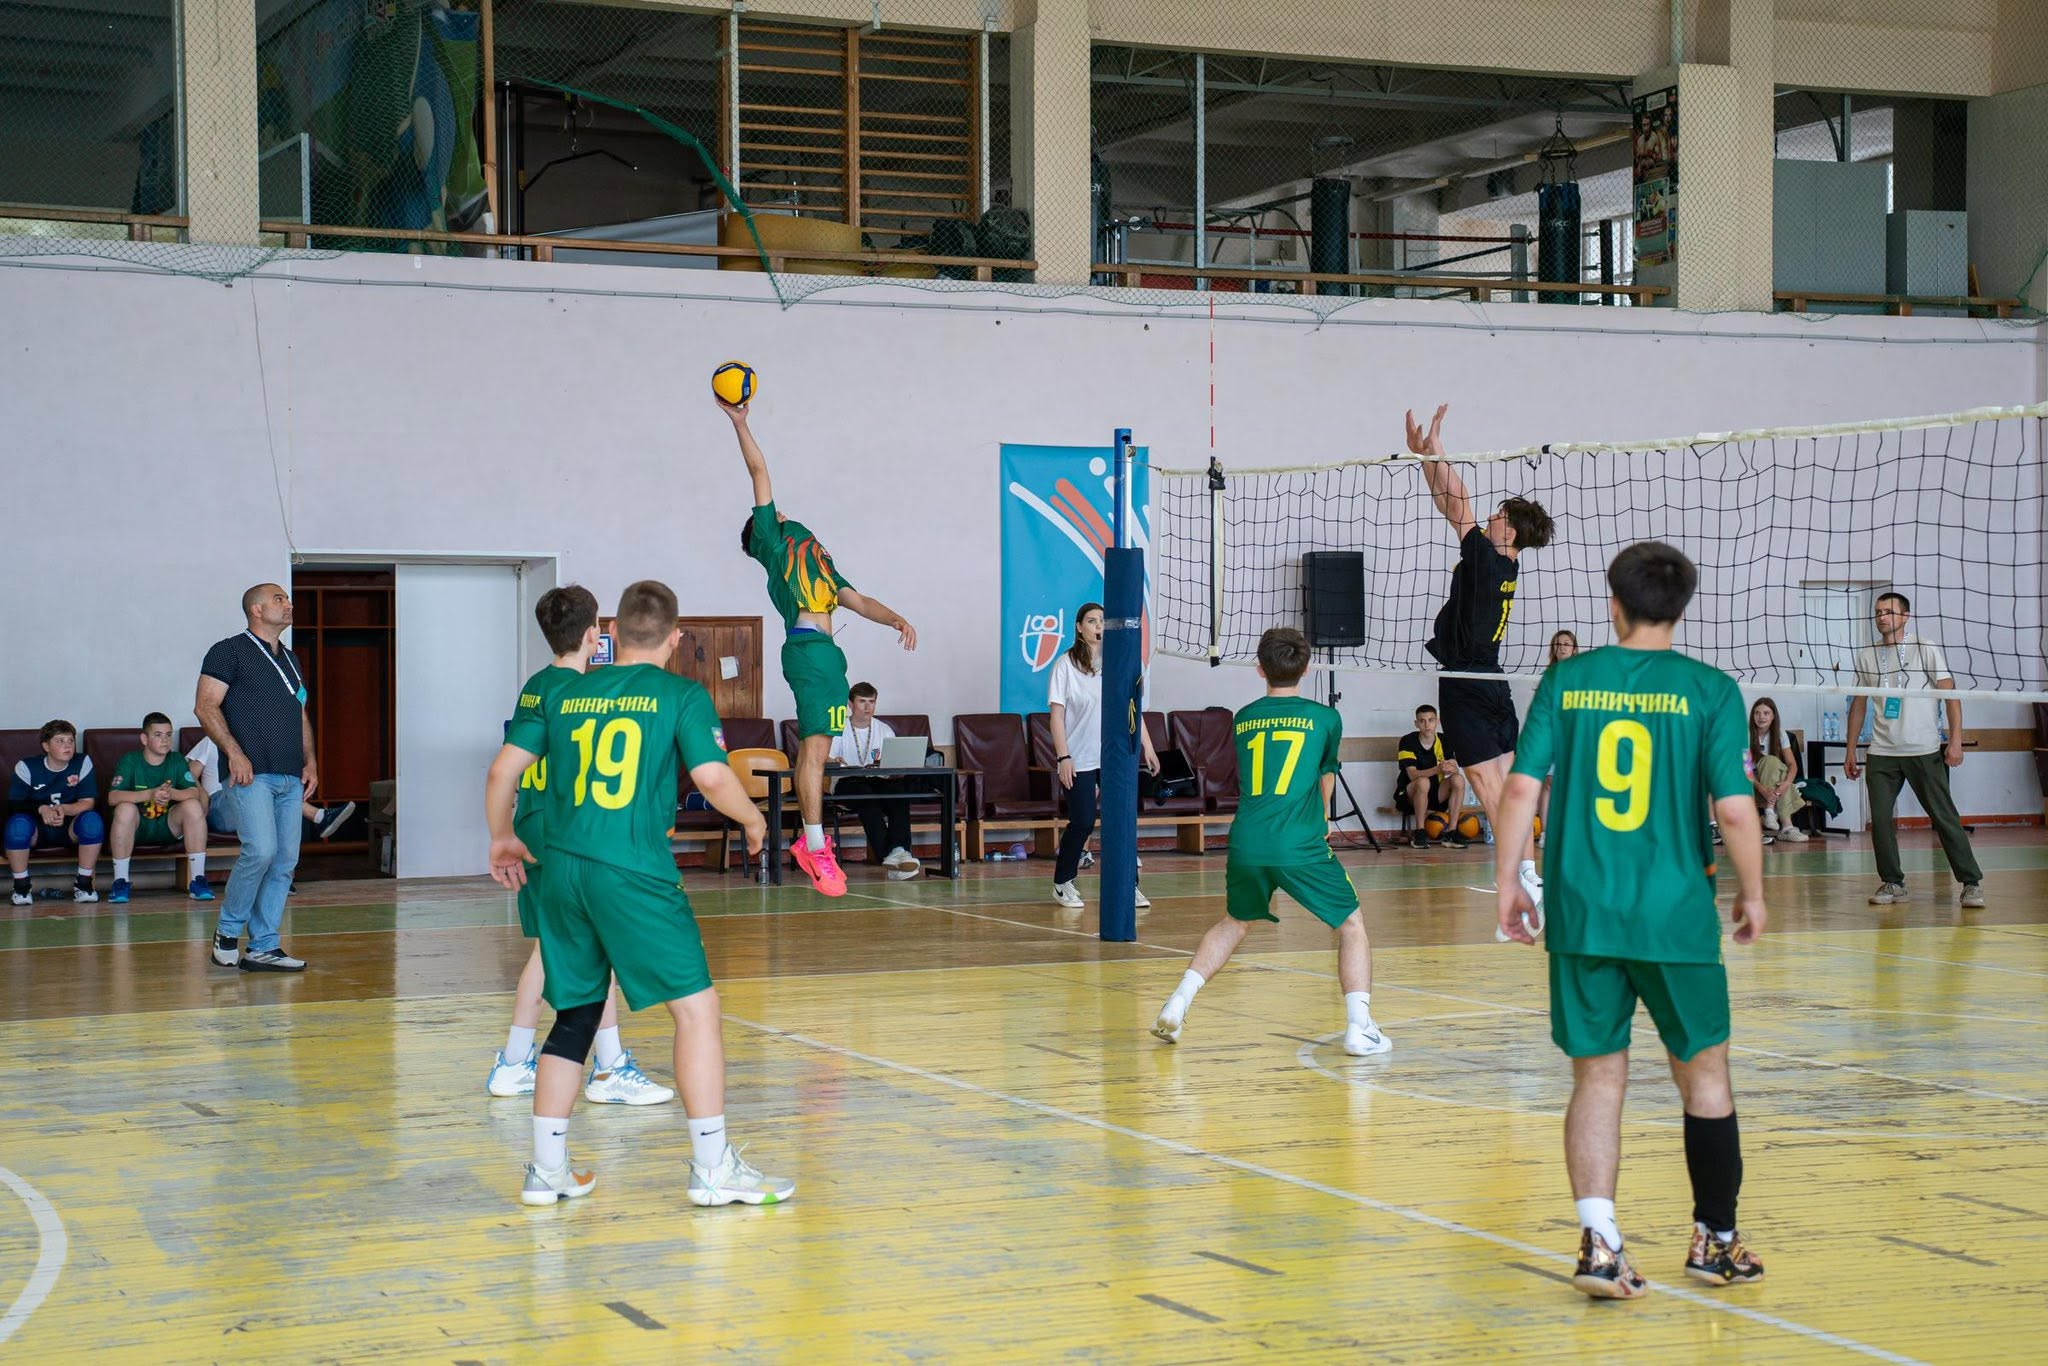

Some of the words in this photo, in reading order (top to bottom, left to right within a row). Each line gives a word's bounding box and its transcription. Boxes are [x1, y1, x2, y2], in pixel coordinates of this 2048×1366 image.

[828, 705, 846, 729] 10
[1236, 717, 1314, 735] ВІННИЧЧИНА
[1562, 690, 1689, 716] ВІННИЧЧИНА
[571, 717, 642, 810] 19
[1247, 730, 1305, 796] 17
[1595, 719, 1653, 832] 9
